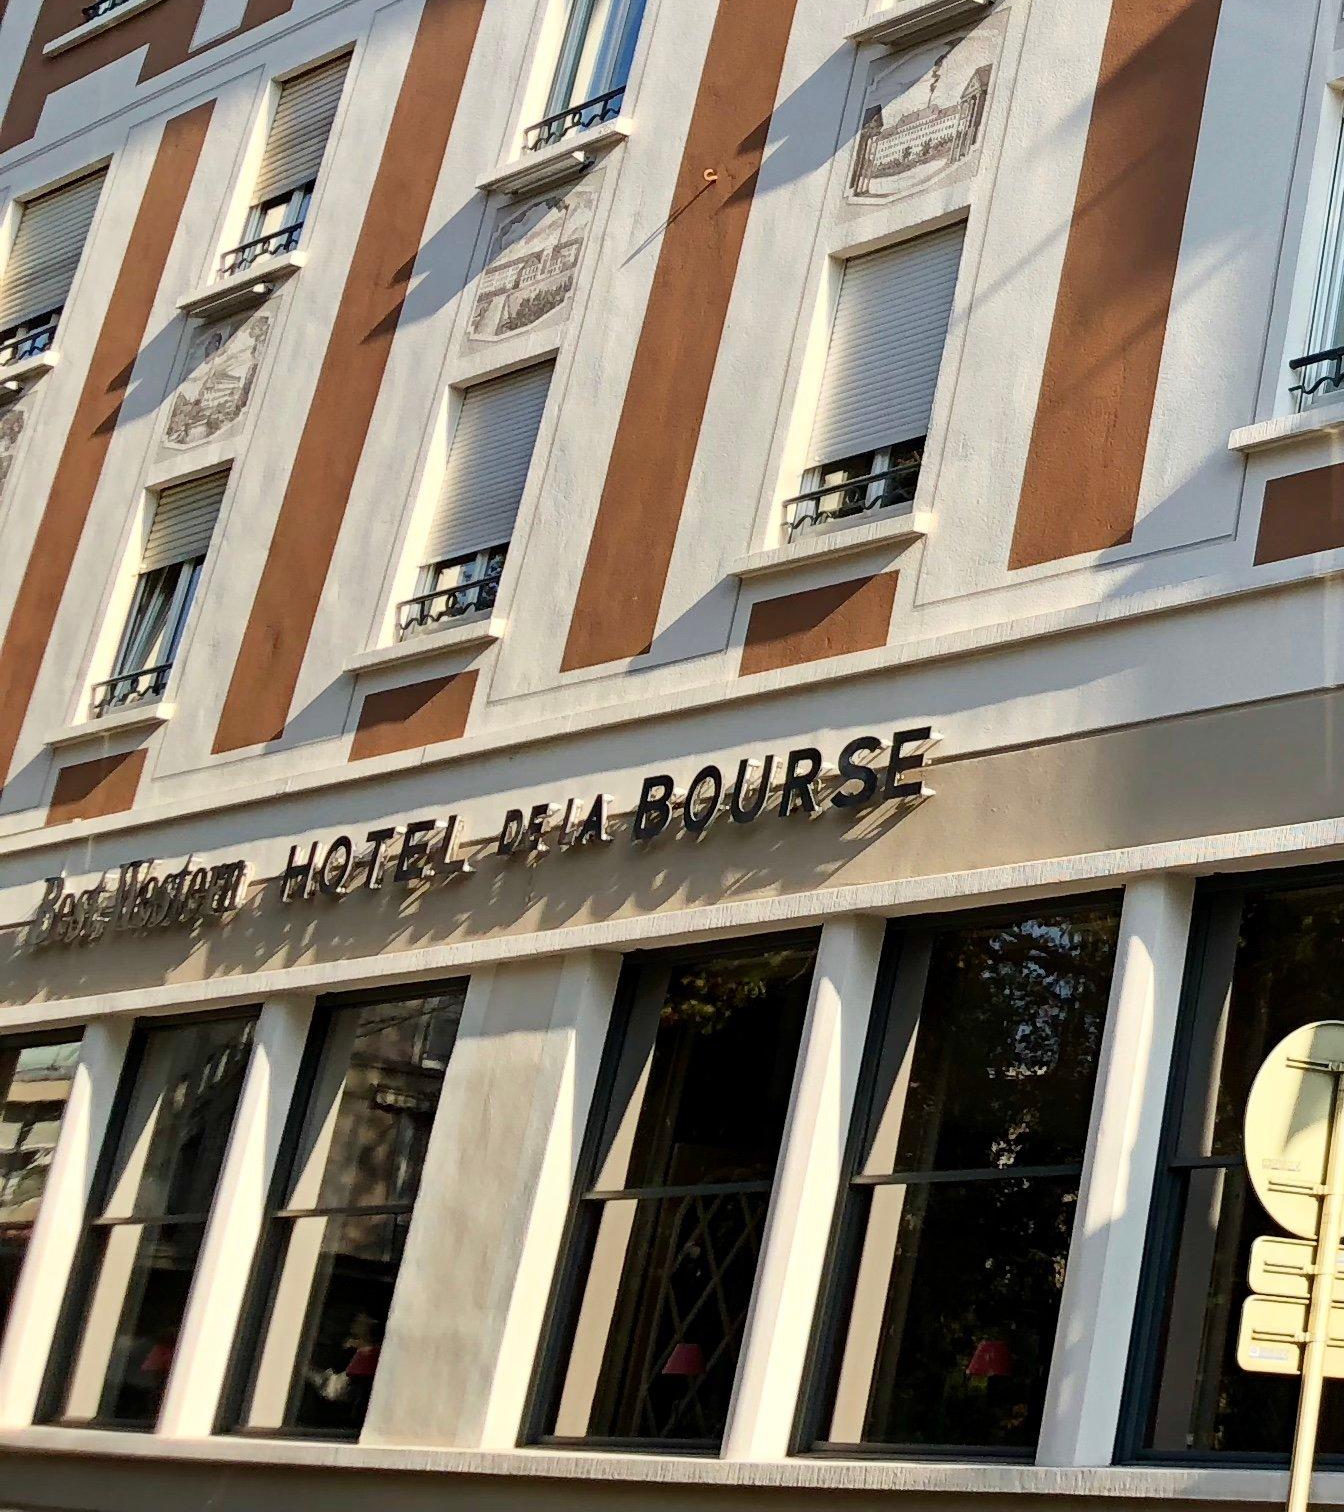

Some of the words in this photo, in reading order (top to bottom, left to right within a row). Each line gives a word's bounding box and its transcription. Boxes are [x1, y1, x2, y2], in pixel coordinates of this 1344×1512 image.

[281, 815, 468, 901] HOTEL
[496, 803, 549, 855] DE
[558, 794, 605, 845] LA
[632, 726, 932, 841] BOURSE
